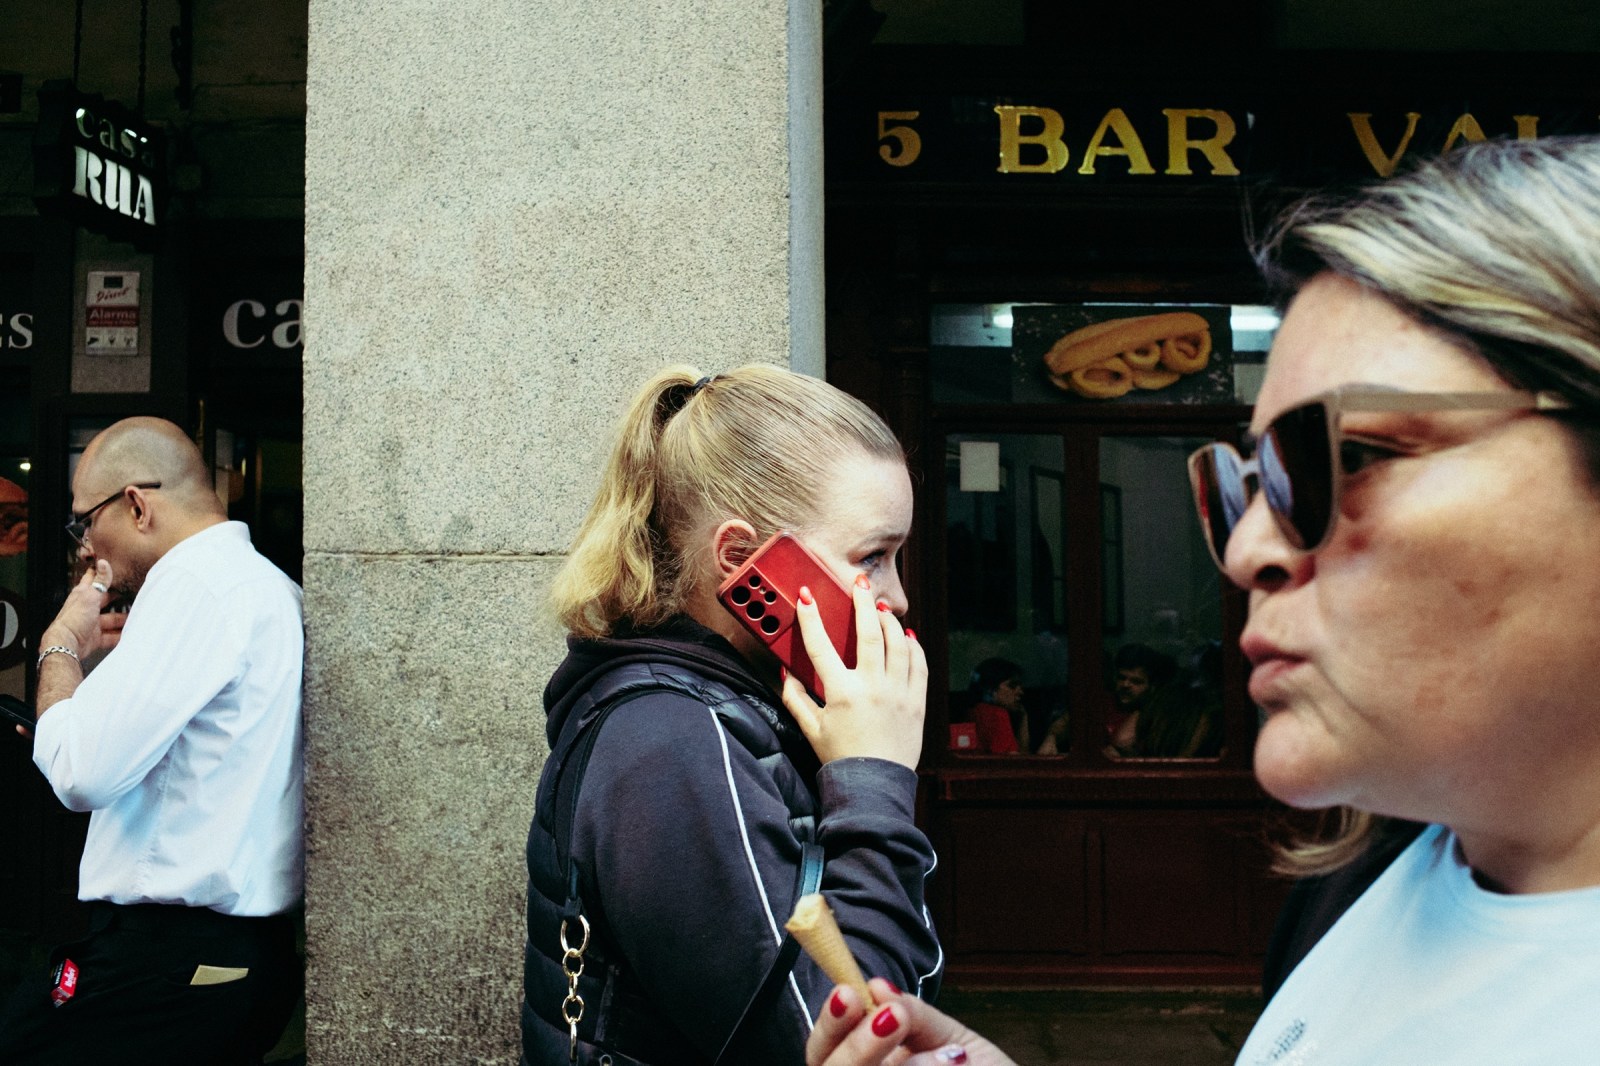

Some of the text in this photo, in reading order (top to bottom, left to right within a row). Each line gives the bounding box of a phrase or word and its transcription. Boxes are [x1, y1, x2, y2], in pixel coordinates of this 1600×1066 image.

[877, 110, 923, 168] 5
[994, 105, 1241, 176] BAR
[72, 141, 157, 226] RUA
[89, 307, 137, 320] Alarma
